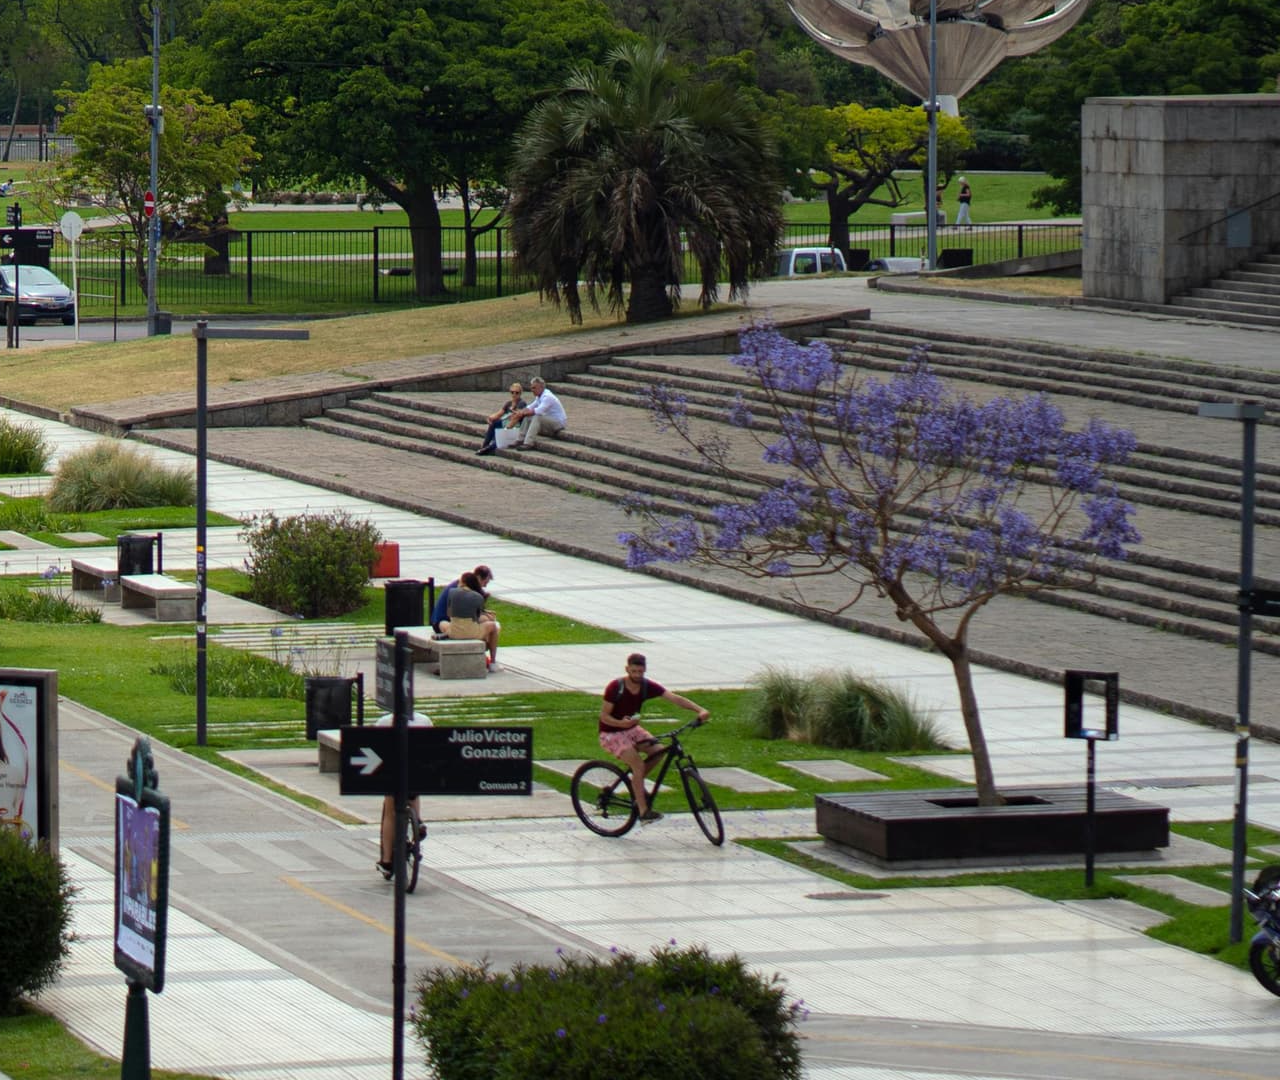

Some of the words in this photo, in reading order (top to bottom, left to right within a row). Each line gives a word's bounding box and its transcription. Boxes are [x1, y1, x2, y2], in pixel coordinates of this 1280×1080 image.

[448, 729, 483, 742] Julio
[461, 745, 527, 759] González
[479, 780, 518, 790] Comuna
[519, 780, 527, 790] 2
